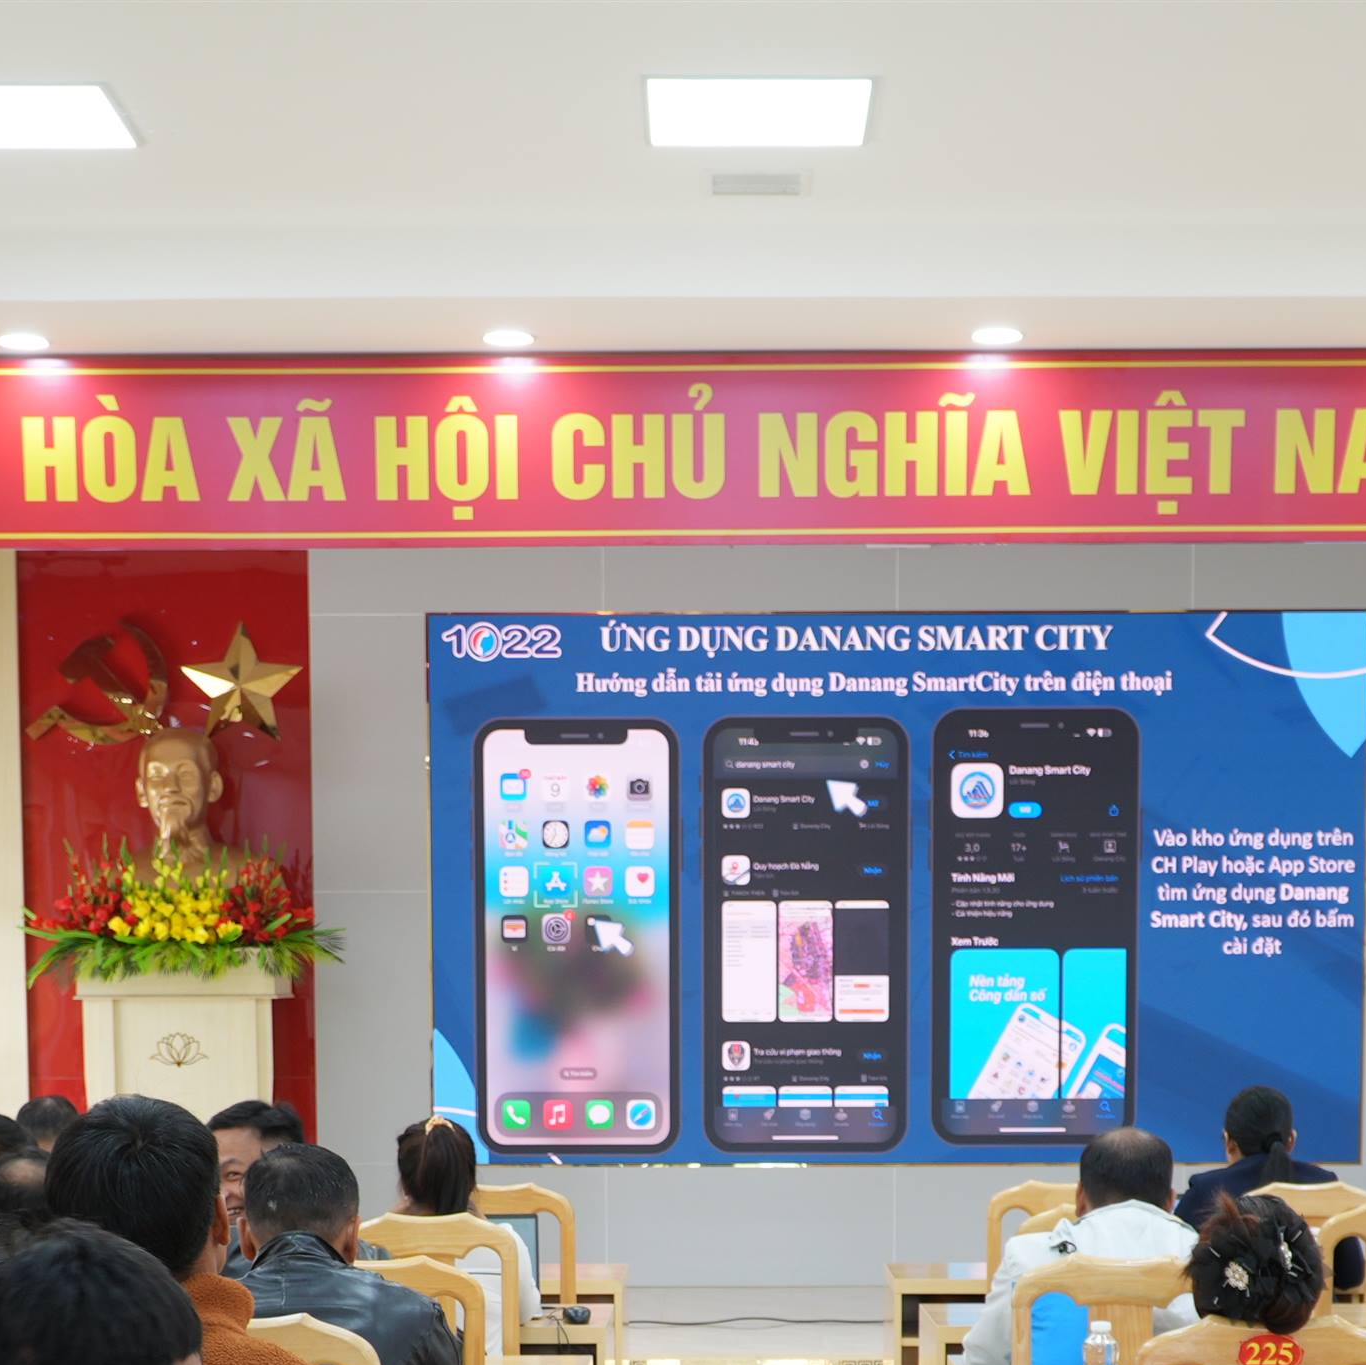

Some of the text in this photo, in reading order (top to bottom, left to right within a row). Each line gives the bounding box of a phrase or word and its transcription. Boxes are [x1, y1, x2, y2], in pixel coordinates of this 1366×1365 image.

[21, 394, 200, 503] HÒA
[227, 397, 346, 502] XÃ
[374, 395, 519, 520] HỘI
[551, 383, 725, 500] CHỦ
[758, 391, 1031, 498] NGHĨA
[1059, 389, 1246, 515] VIỆT
[441, 621, 562, 662] 1022
[600, 618, 1114, 659] ỨNG DỤNG DANANG SMART CITY
[575, 667, 1173, 698] Hướng dẫn tải ứng dụng Danang SmartCity trên điện thoại
[1008, 765, 1092, 776] Danang Smart City
[753, 794, 816, 805] Danang Smart City
[1153, 827, 1354, 850] Vào kho ứng dụng trên
[1151, 855, 1356, 877] CH Play hoặc App Store
[1157, 882, 1350, 905] tìm ứng dụng Danang
[1150, 907, 1355, 932] Smart City, sau đó bấm
[1222, 936, 1282, 958] cài đặt
[969, 989, 1002, 1004] Công
